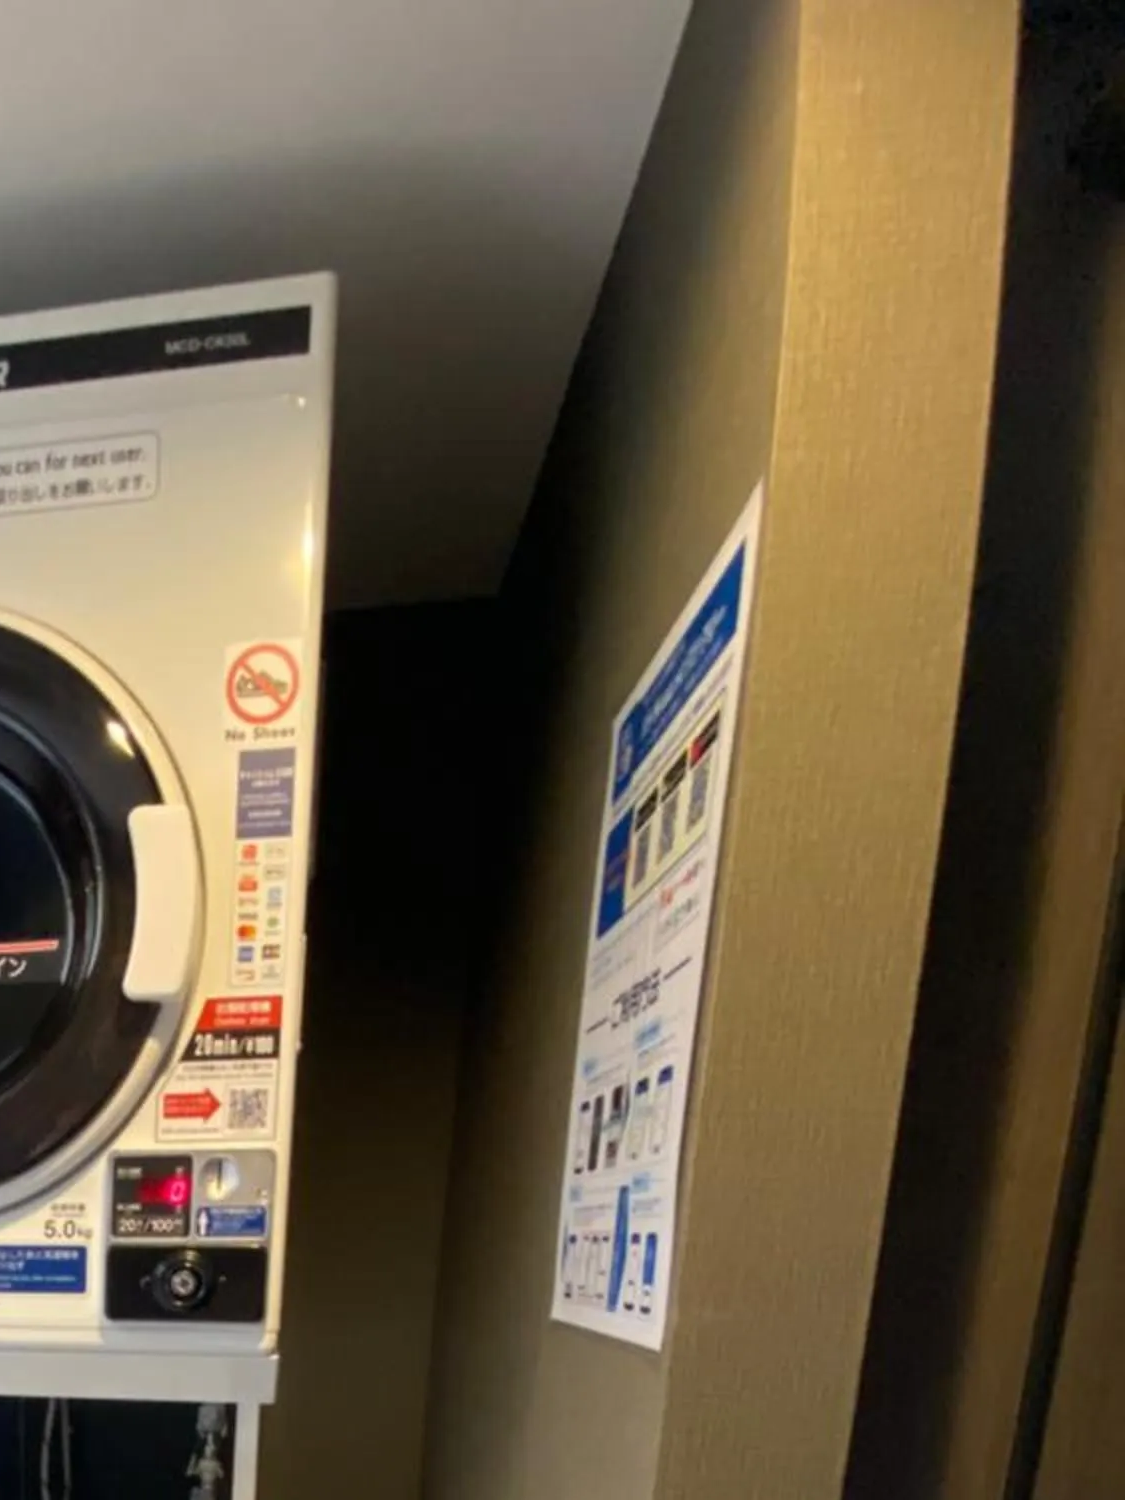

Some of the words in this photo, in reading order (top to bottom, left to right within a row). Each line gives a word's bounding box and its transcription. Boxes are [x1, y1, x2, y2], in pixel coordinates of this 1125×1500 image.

[15, 460, 40, 475] can
[45, 453, 67, 472] for
[169, 1180, 185, 1202] 0
